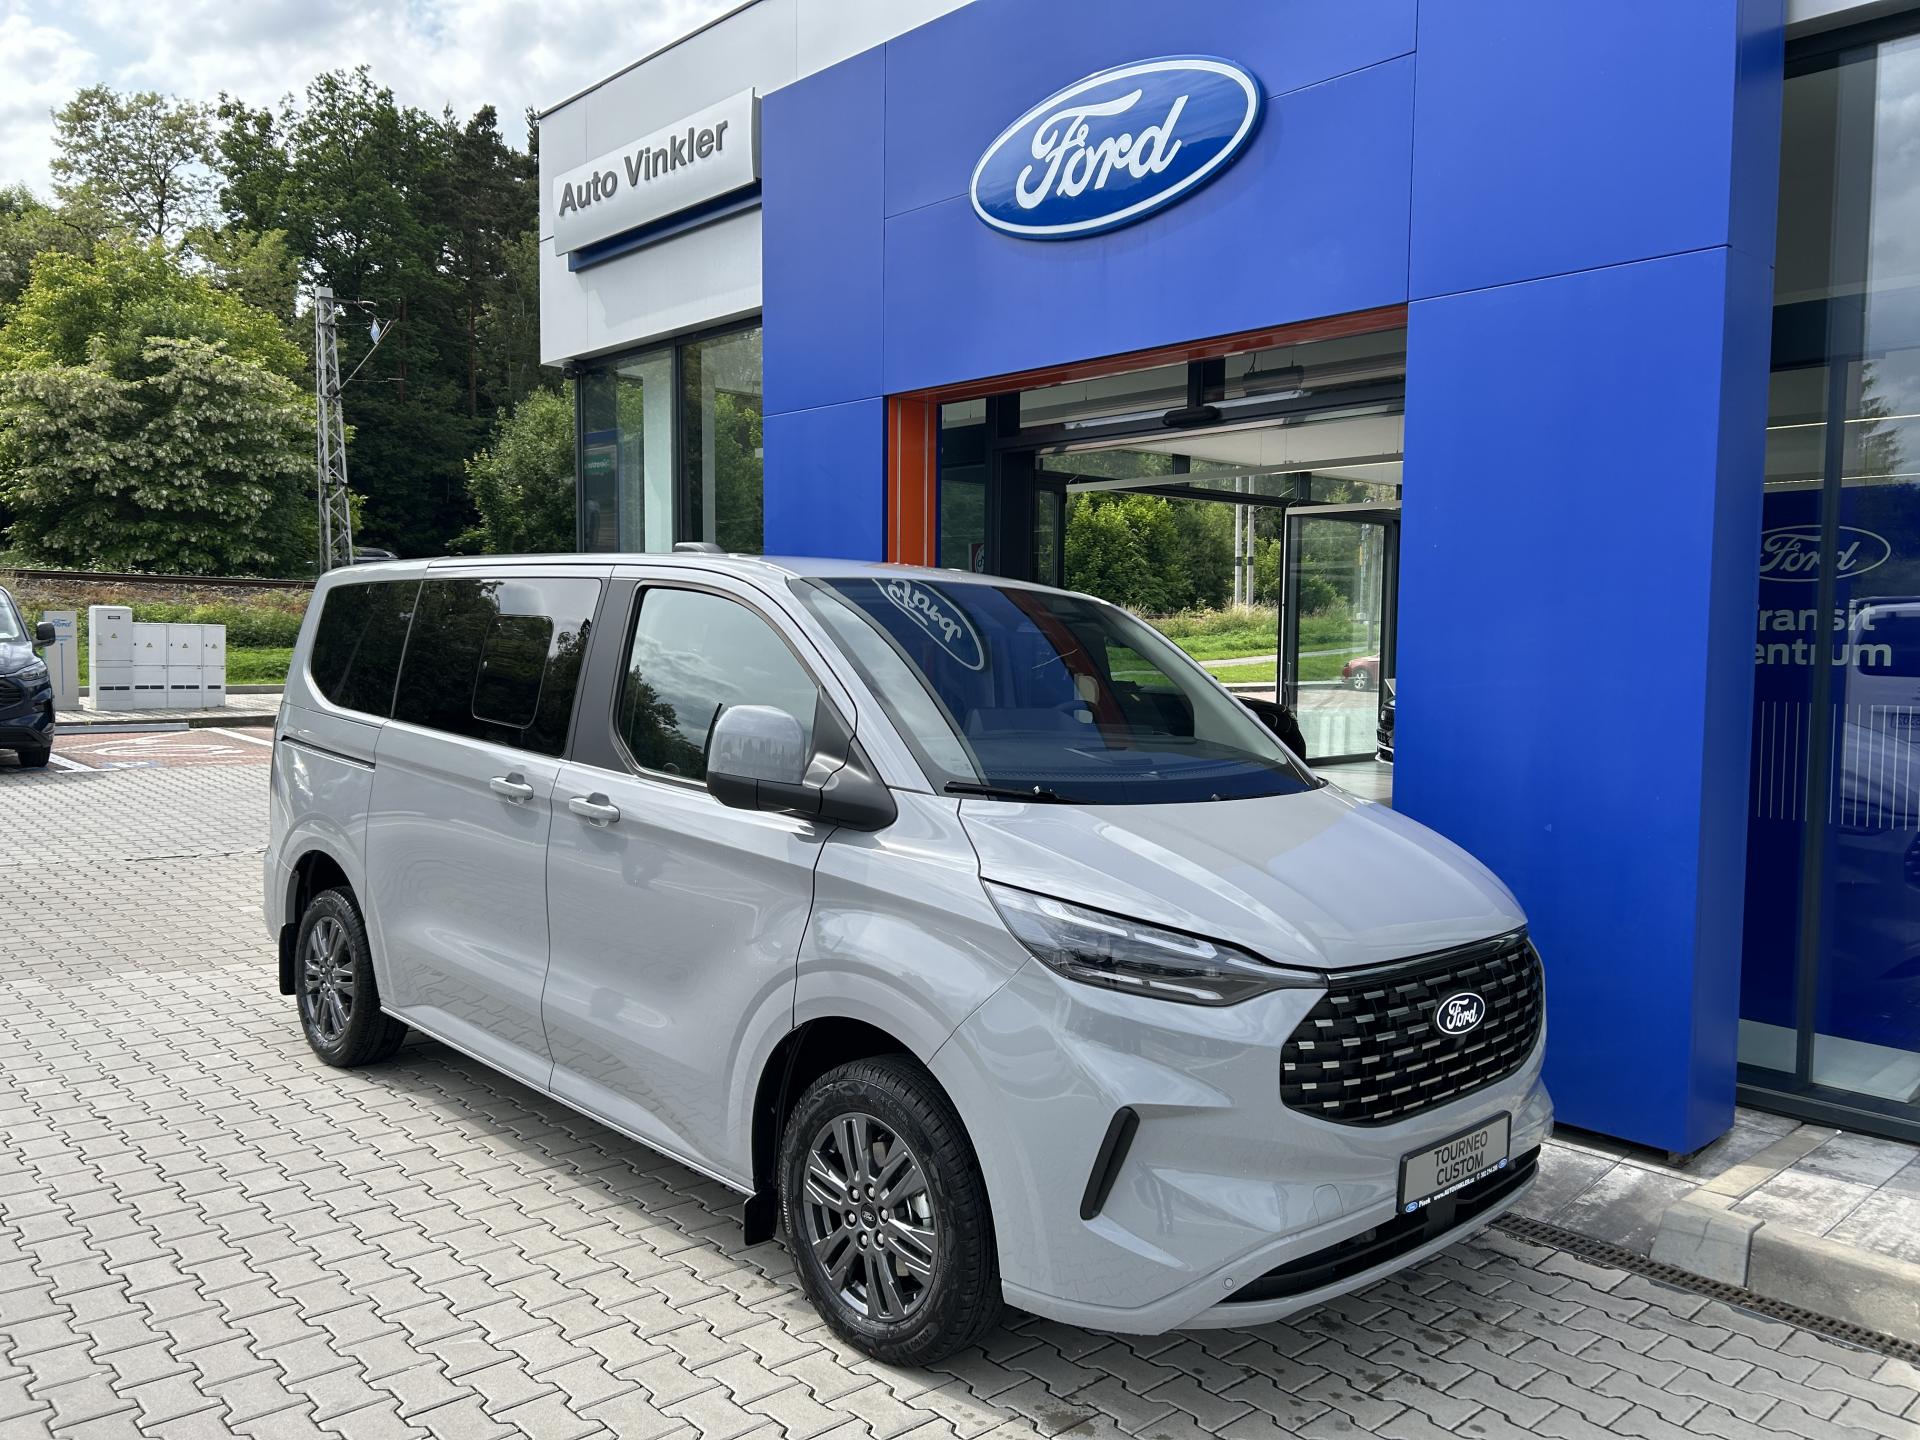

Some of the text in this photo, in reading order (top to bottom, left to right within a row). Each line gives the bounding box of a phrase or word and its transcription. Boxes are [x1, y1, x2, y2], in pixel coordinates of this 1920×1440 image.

[1016, 89, 1189, 209] Ford
[559, 120, 728, 216] Auto Vinkler
[1758, 600, 1876, 631] ransit
[1755, 638, 1892, 667] entum
[1446, 998, 1478, 1030] Ford
[1434, 1131, 1488, 1167] TOURNEO
[1436, 1151, 1484, 1186] CUSTOM
